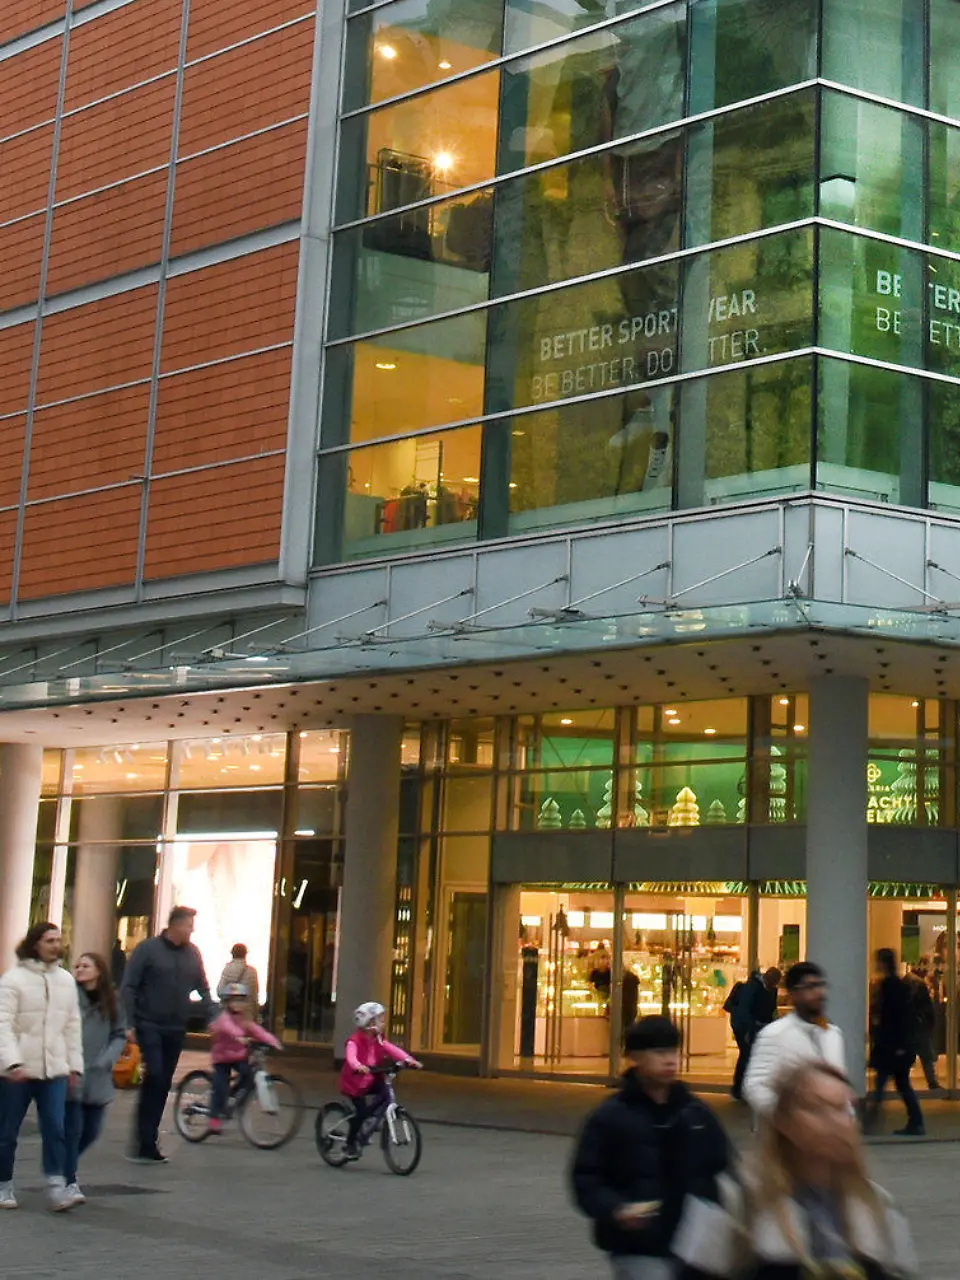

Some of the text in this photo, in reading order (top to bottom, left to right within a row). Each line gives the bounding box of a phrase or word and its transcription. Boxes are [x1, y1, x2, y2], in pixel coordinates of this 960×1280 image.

[876, 270, 960, 314] BEER
[540, 323, 612, 361] BETTER
[646, 348, 673, 376] DO
[708, 328, 768, 362] TTER.
[867, 809, 894, 823] ELT
